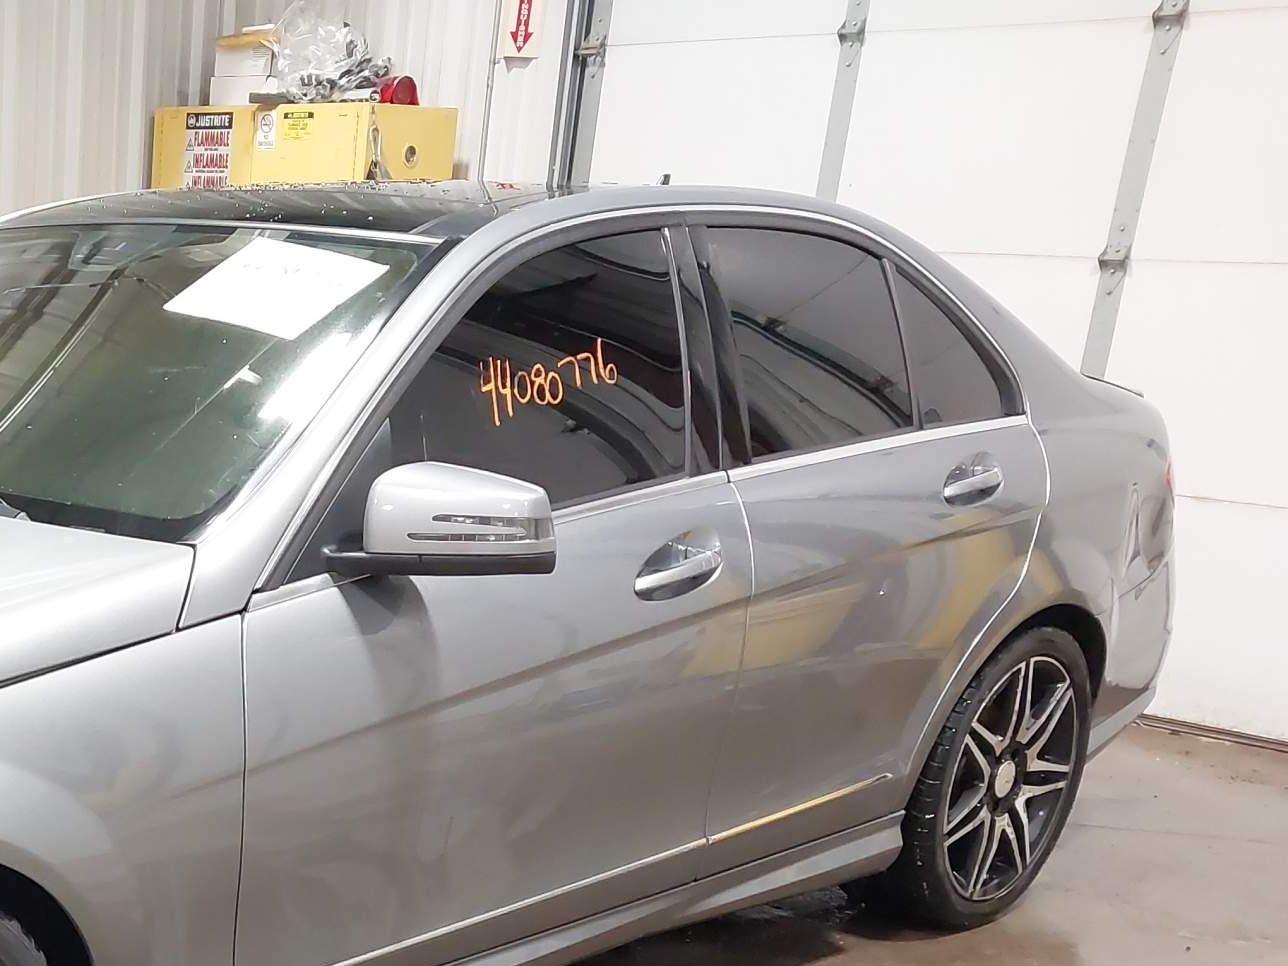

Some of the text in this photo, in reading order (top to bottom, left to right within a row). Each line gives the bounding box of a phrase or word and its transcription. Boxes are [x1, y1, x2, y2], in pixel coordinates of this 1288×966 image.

[196, 114, 230, 127] JUSTRITE
[194, 131, 230, 147] FLAMMABLE
[192, 153, 229, 169] INFLAMABLE
[479, 337, 618, 426] 44080776
